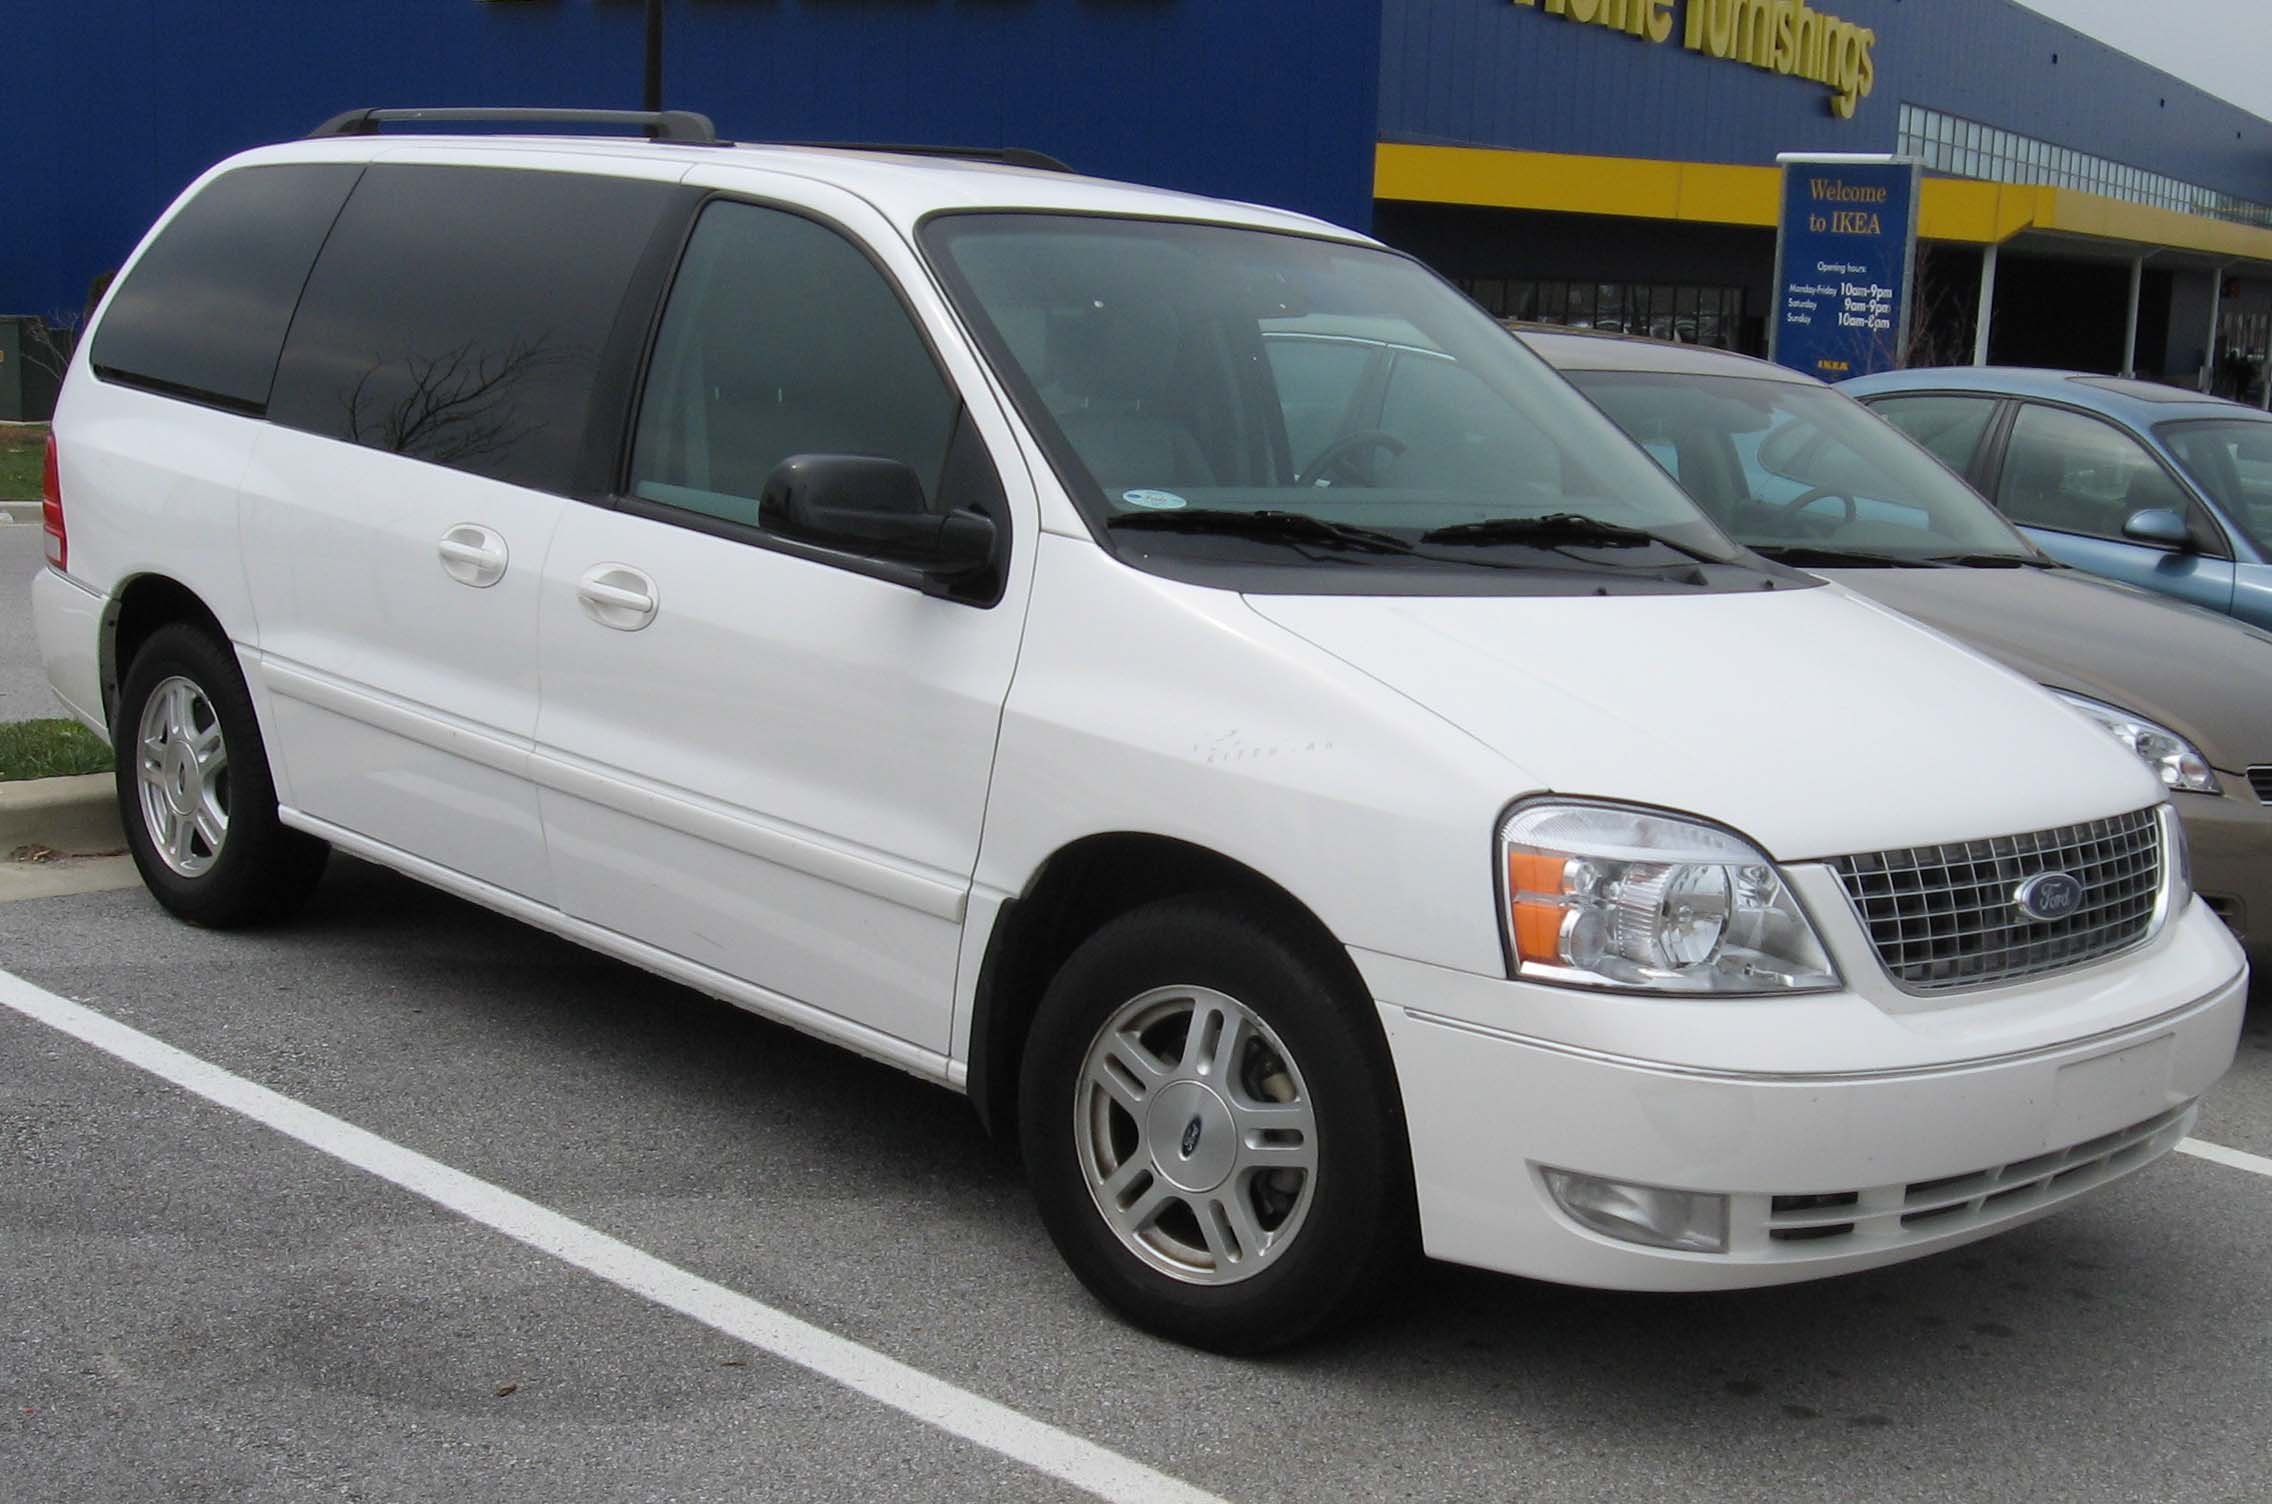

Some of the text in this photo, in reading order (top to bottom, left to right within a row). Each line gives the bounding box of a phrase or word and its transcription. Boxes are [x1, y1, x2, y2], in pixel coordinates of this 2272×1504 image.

[1809, 178, 1887, 202] Welcome
[1809, 212, 1880, 234] to IKEA
[1817, 261, 1867, 274] Opening hours
[1789, 282, 1893, 301] Monday-Friday 10am-9pm
[1788, 298, 1891, 316] Saturday 9am-9pm
[1787, 312, 1811, 325] Sunday
[2040, 882, 2070, 911] Ford
